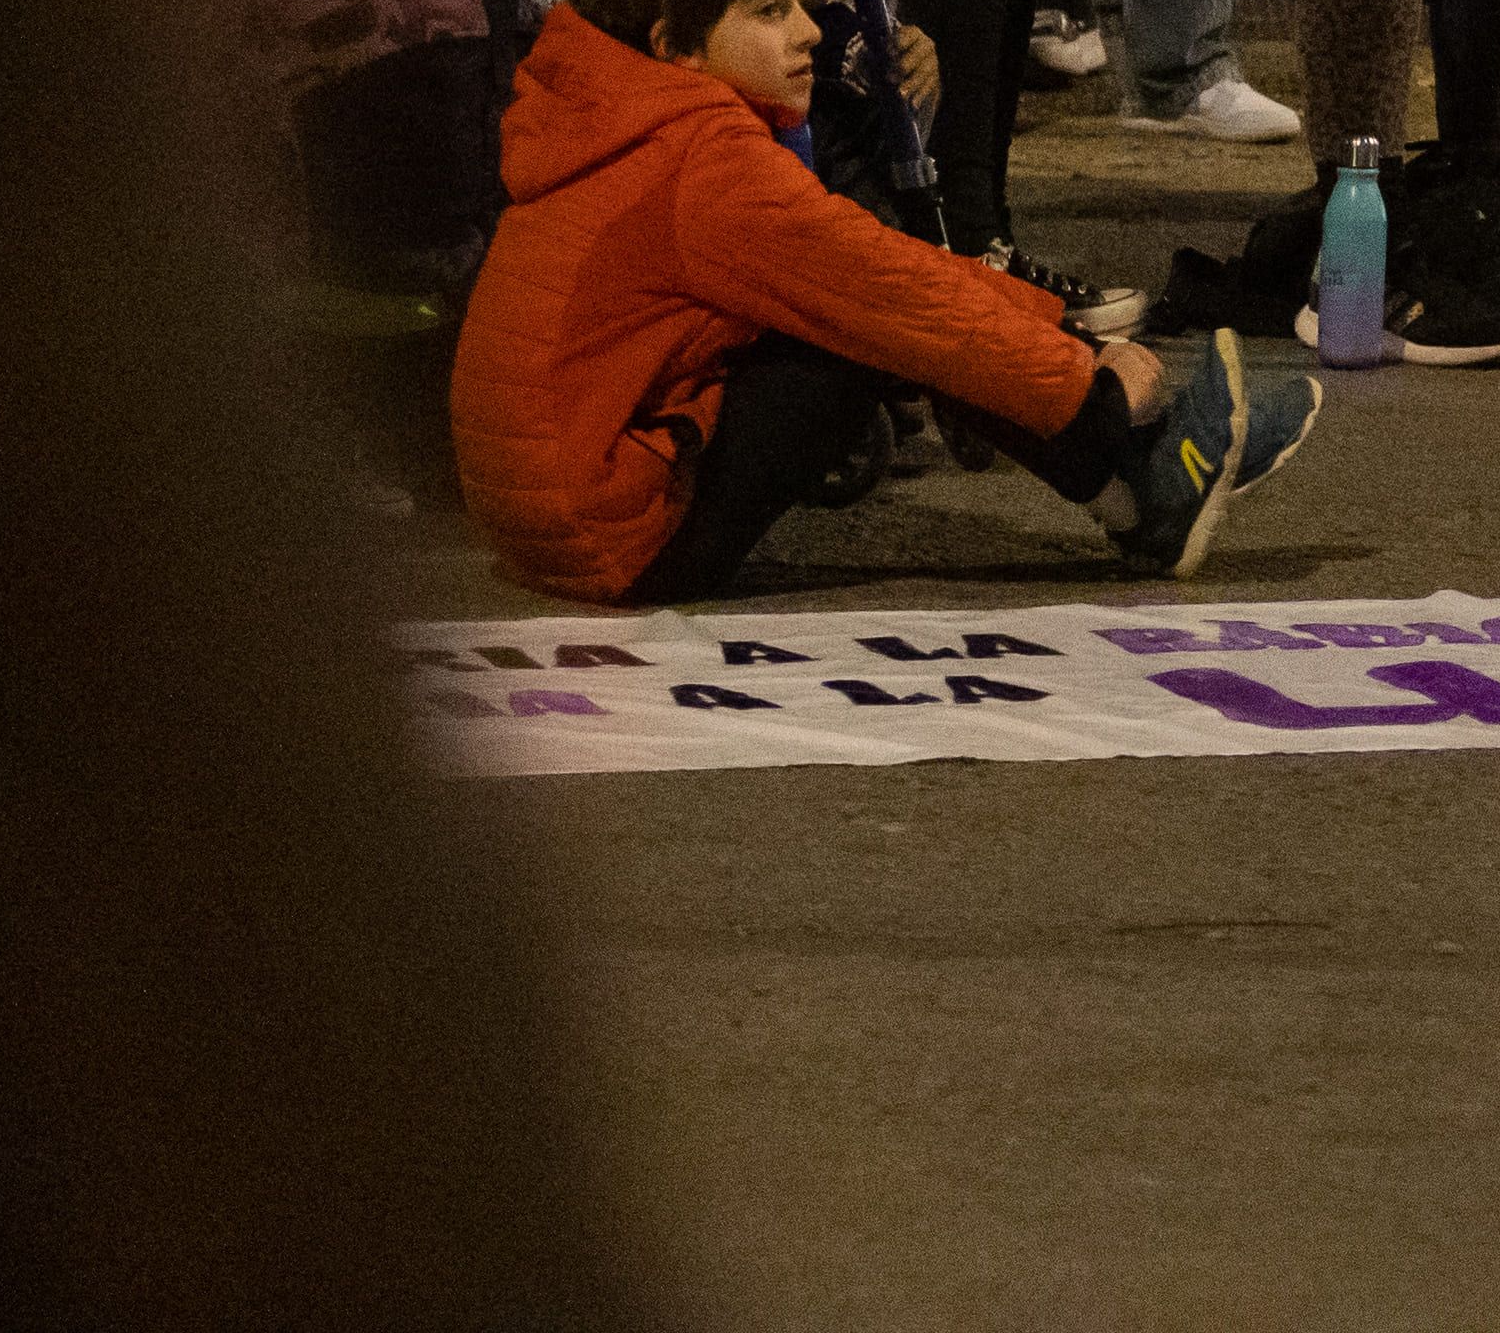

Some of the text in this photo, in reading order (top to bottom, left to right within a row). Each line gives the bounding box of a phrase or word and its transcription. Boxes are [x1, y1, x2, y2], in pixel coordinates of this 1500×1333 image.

[718, 640, 820, 665] A
[854, 633, 1068, 662] LA
[668, 683, 784, 710] A
[821, 675, 1053, 706] LA
